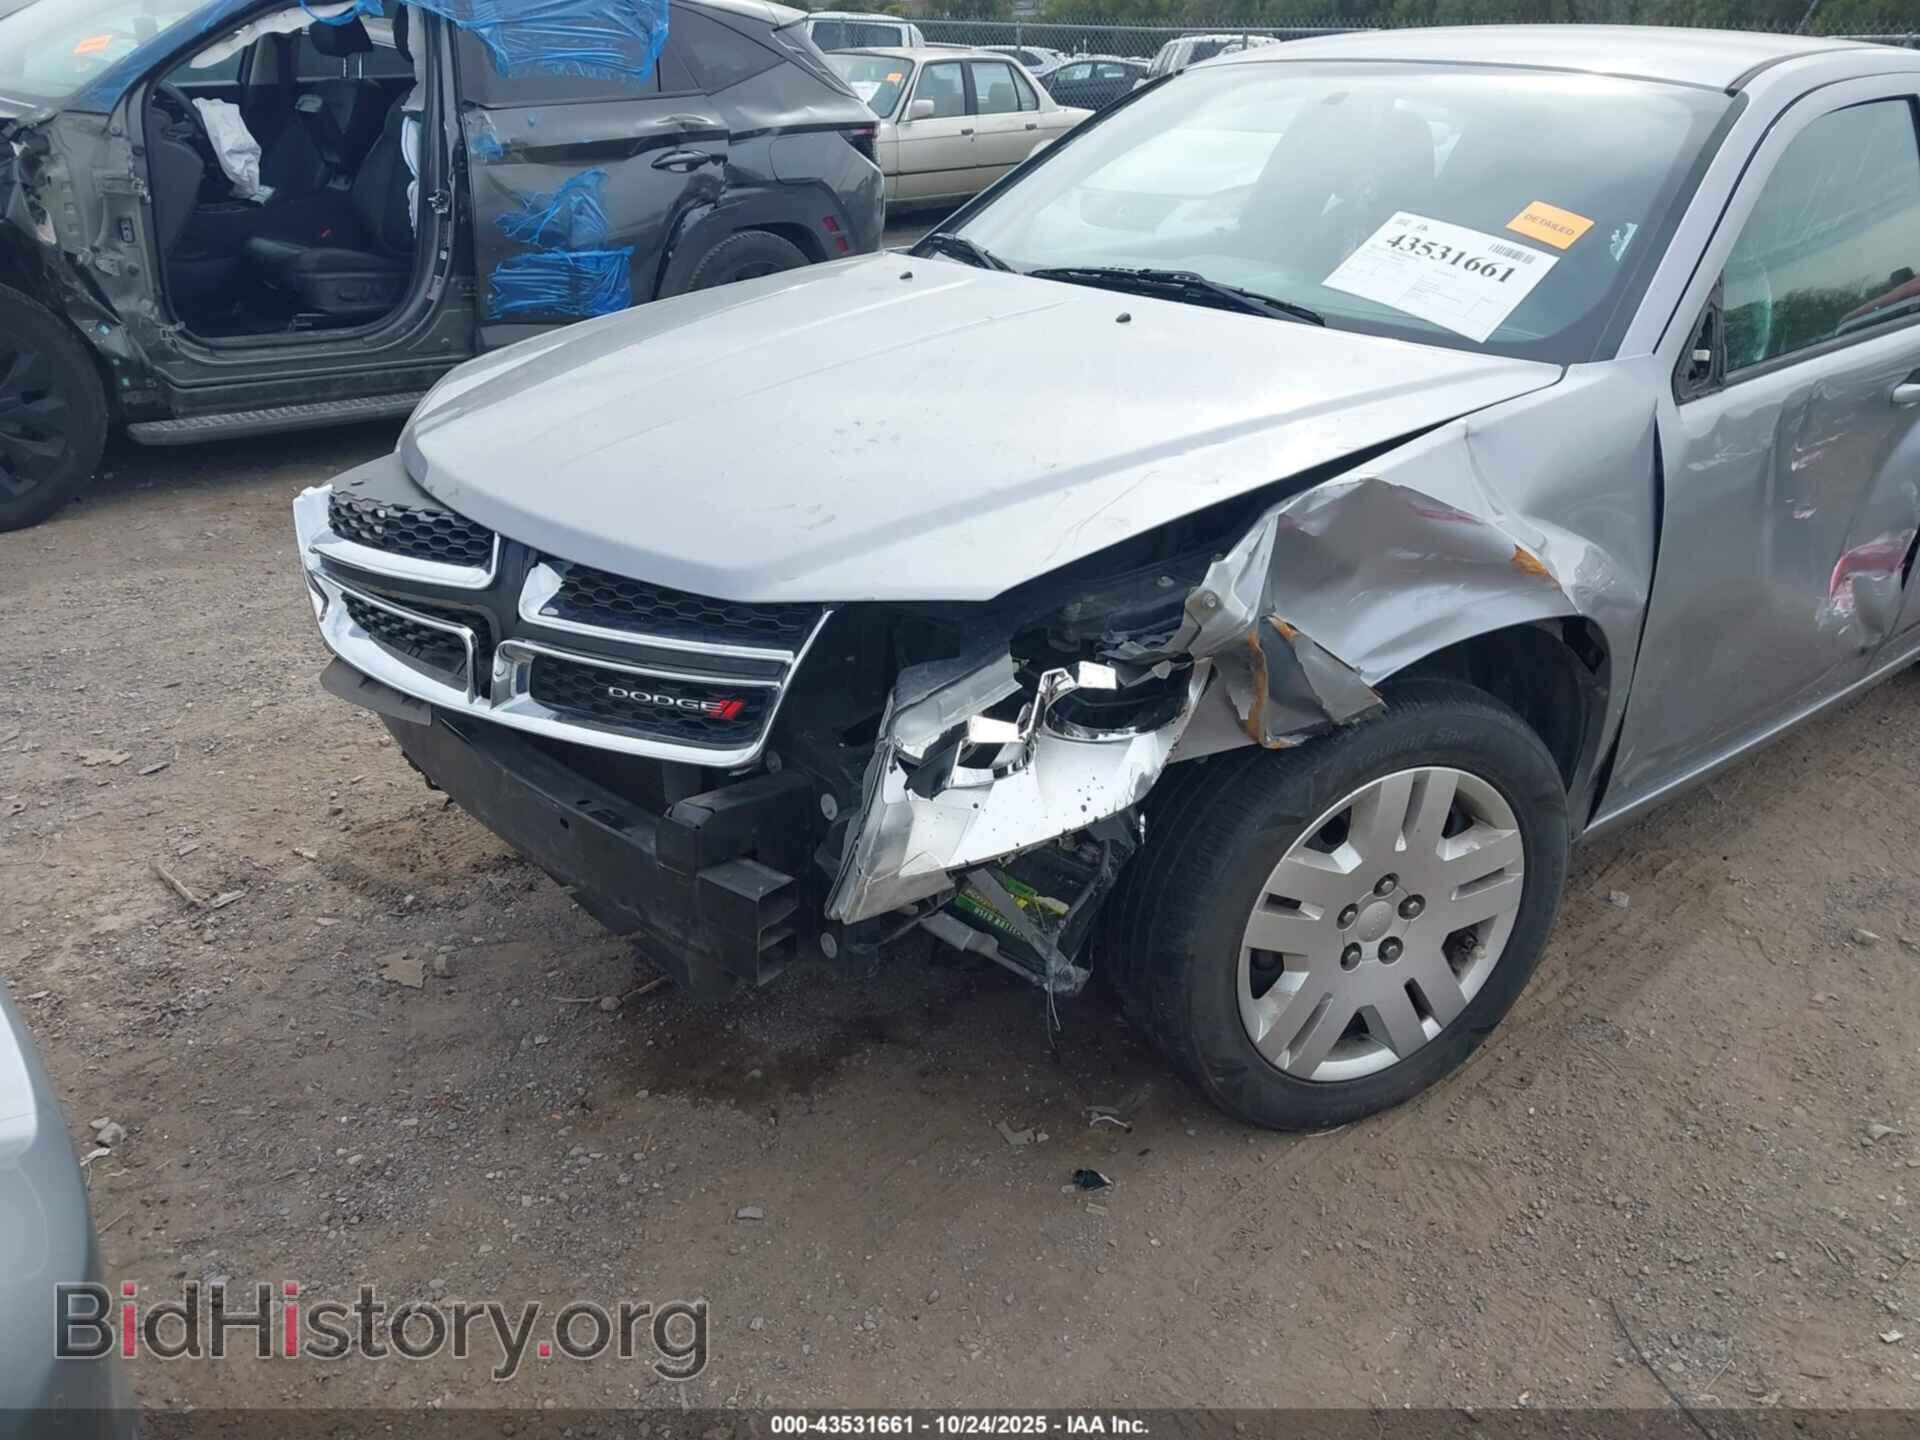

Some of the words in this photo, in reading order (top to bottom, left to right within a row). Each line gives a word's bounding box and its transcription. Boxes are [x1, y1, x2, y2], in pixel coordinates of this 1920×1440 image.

[1524, 214, 1575, 236] DETAILED
[1386, 233, 1516, 283] 43531661
[608, 686, 723, 713] DODGE
